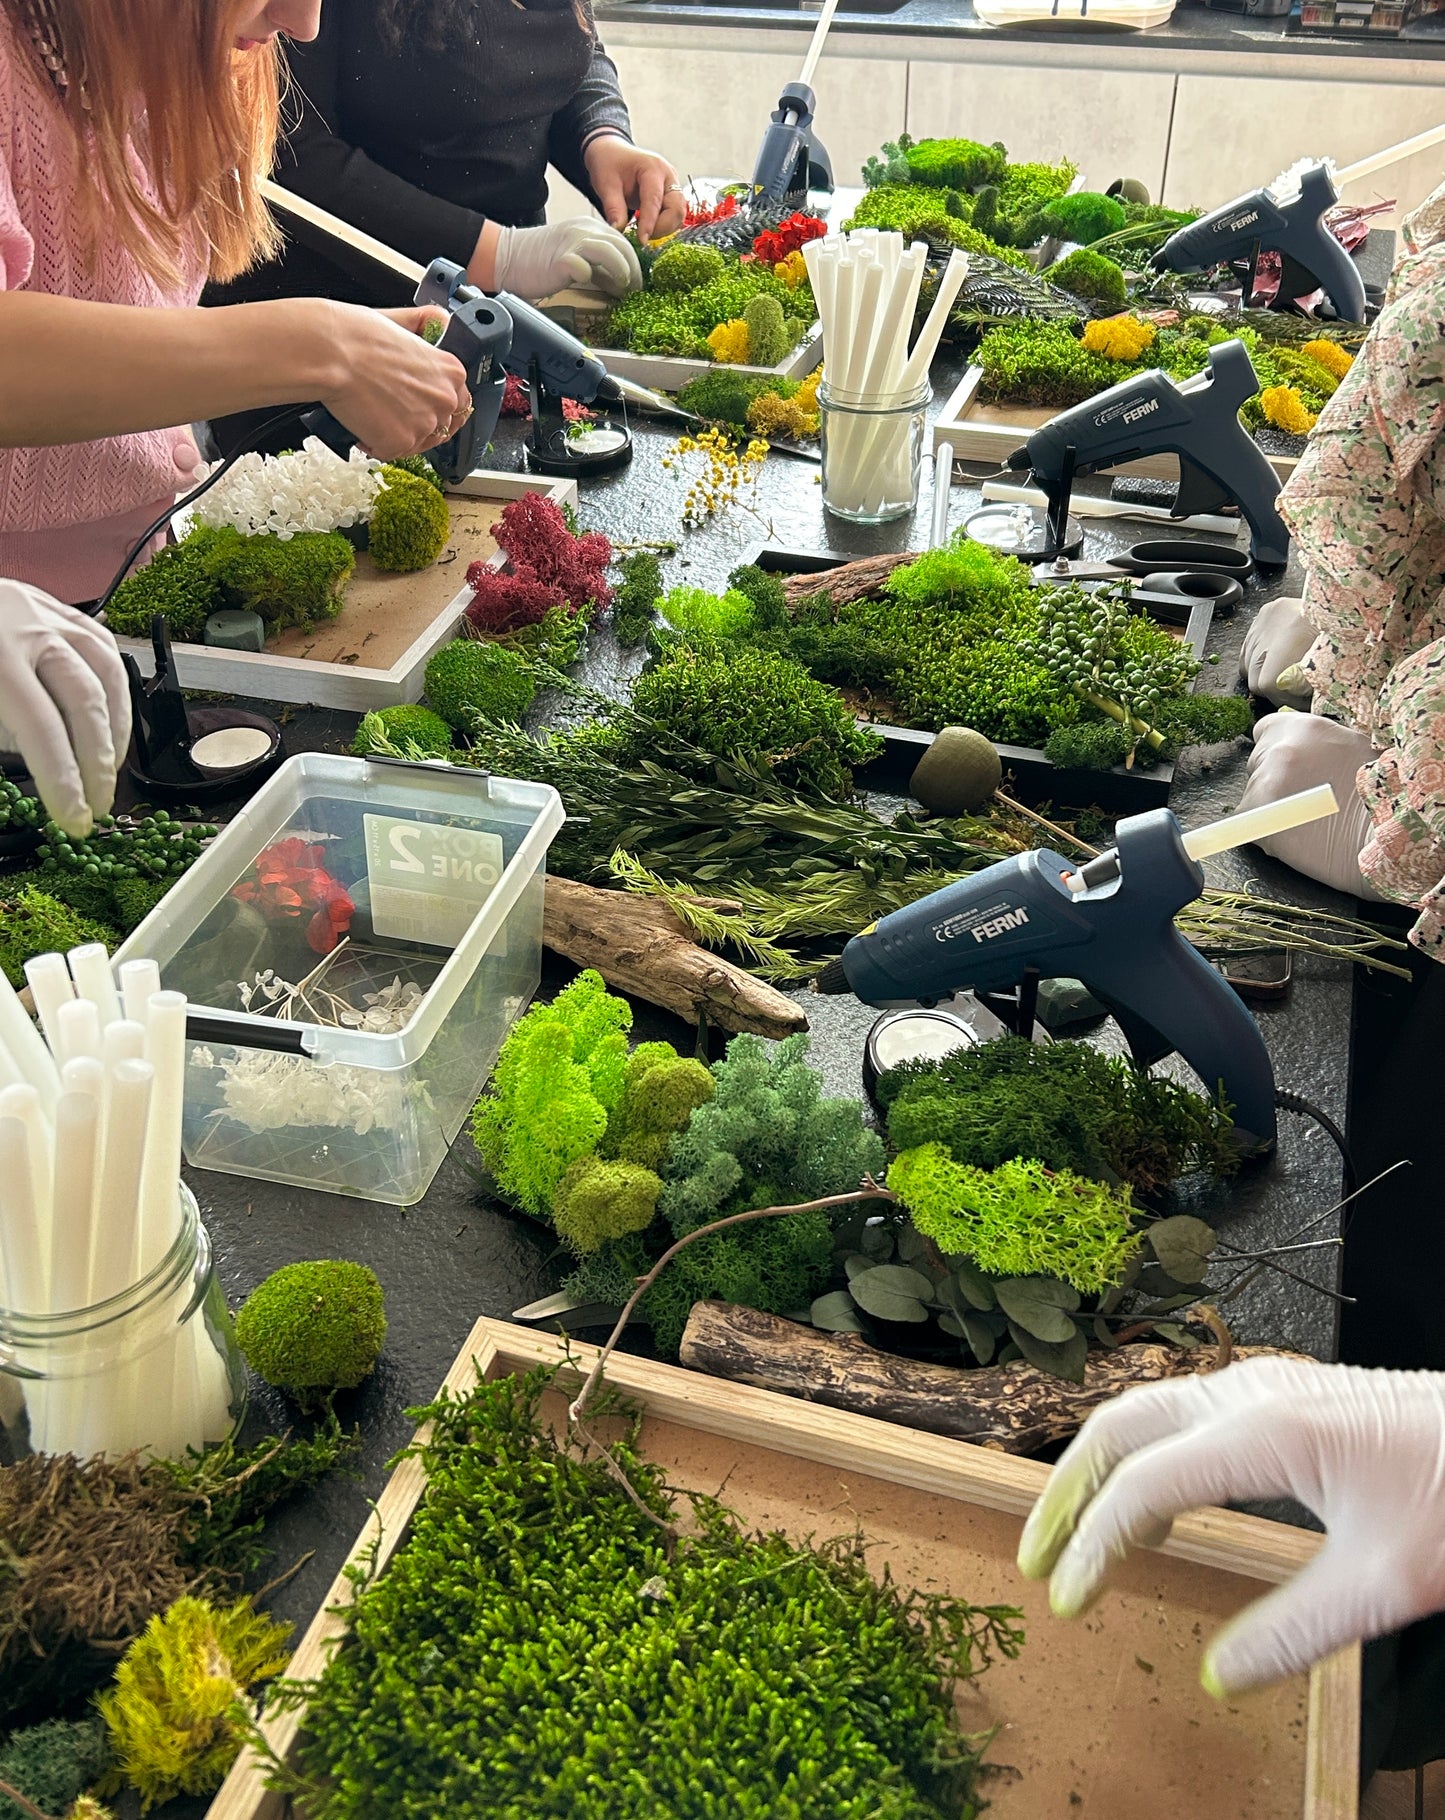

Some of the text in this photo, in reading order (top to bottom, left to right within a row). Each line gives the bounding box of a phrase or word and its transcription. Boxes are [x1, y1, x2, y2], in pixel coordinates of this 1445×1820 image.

[1230, 211, 1259, 232] FERM
[1122, 399, 1159, 425] FERM
[970, 907, 1030, 943] FERM
